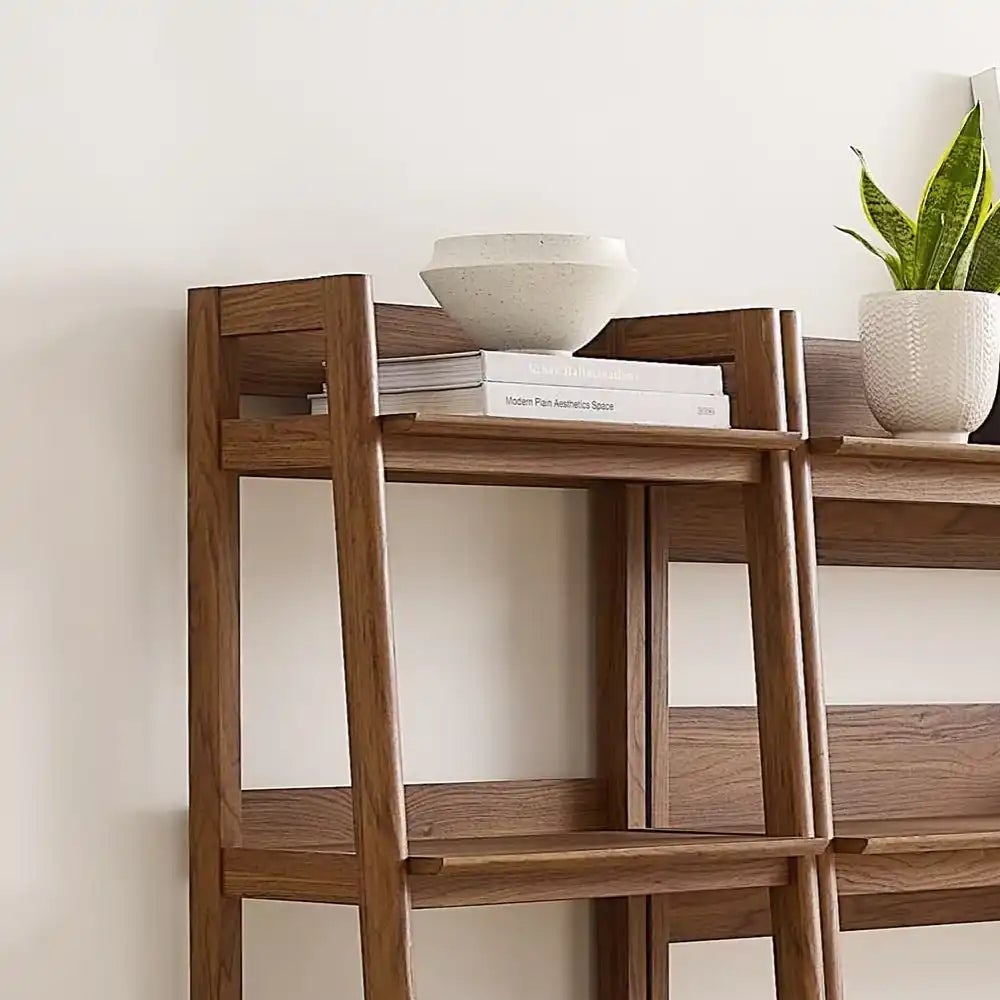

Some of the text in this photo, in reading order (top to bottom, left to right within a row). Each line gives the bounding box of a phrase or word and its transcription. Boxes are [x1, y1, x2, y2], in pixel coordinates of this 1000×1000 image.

[505, 396, 615, 411] Modern Plain Aesthetics Space
